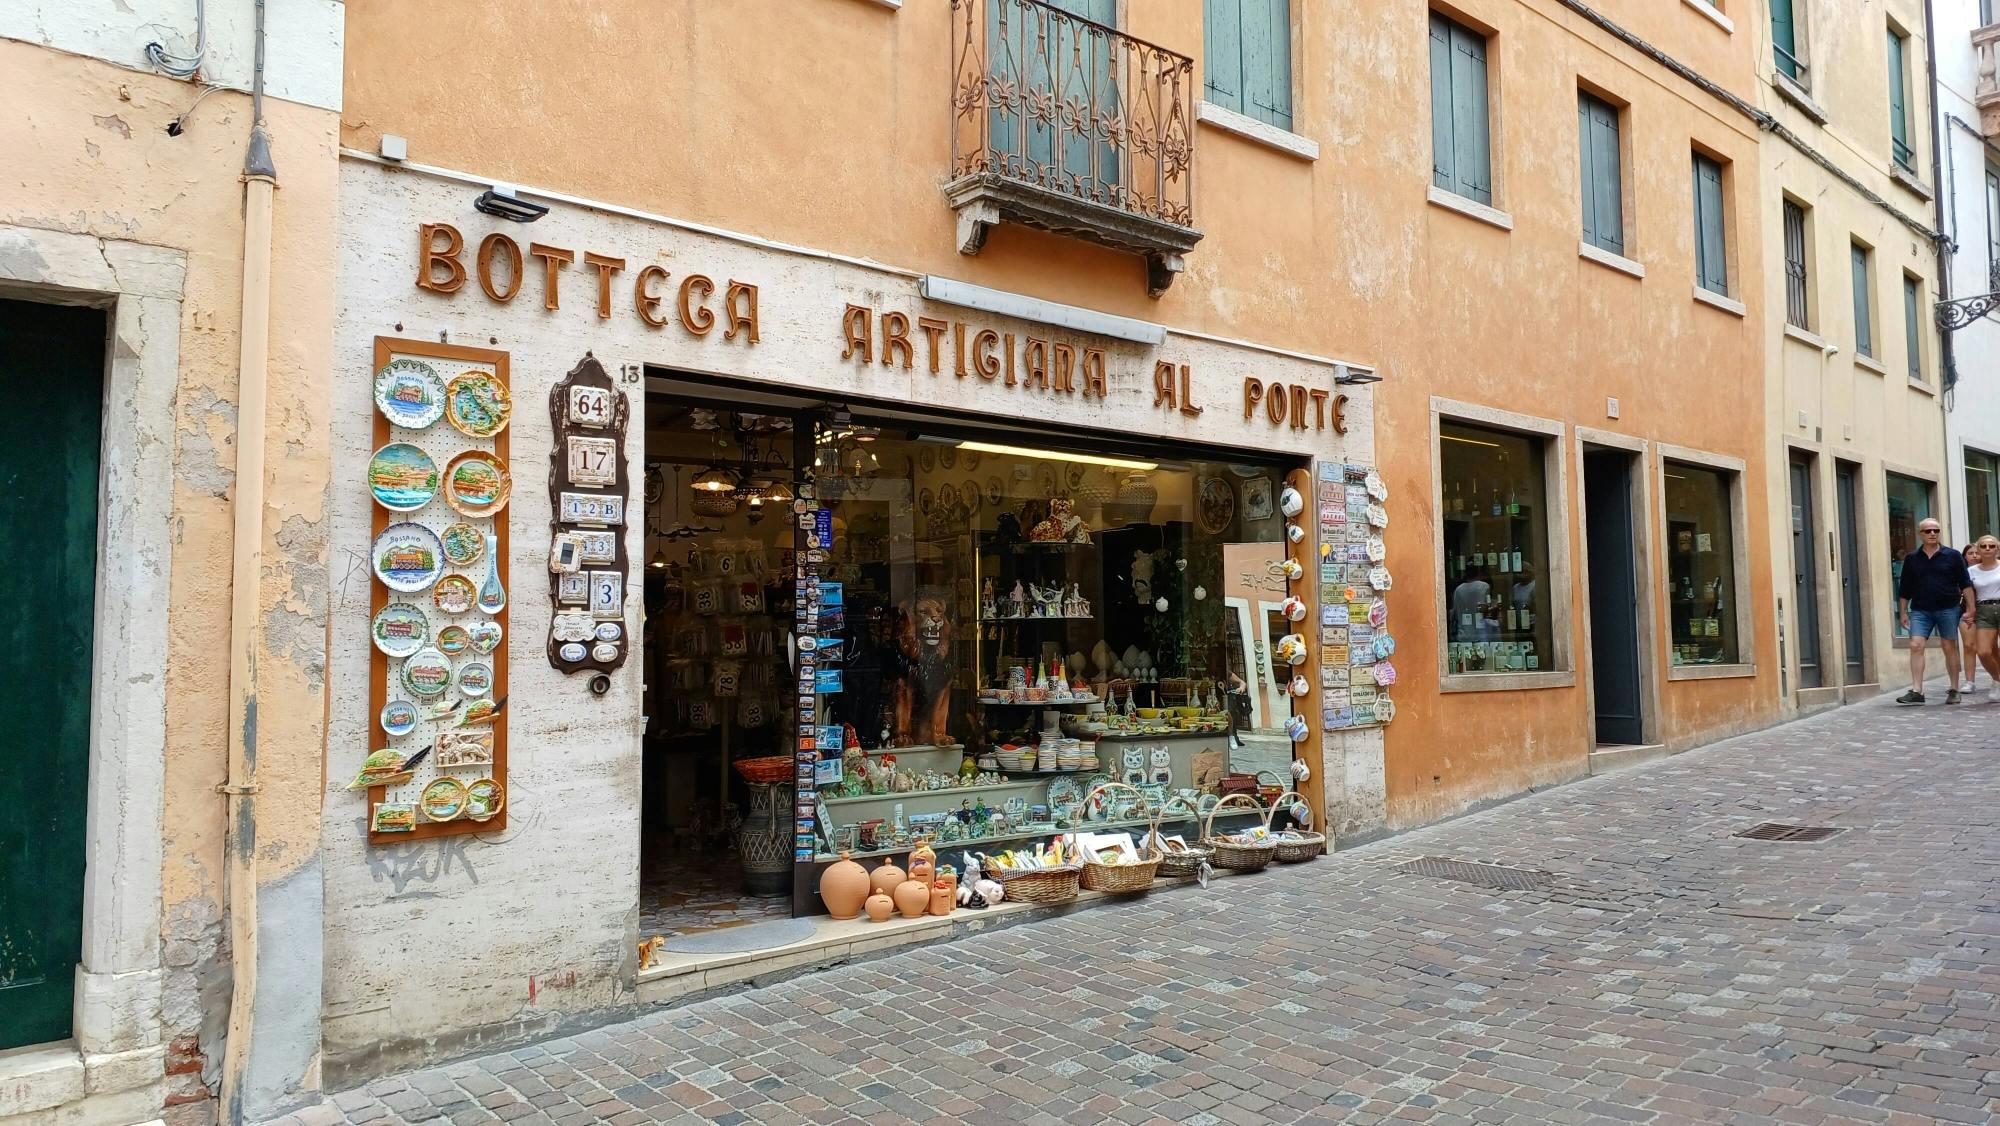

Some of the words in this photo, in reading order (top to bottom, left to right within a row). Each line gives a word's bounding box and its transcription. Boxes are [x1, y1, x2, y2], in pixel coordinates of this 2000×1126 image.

[415, 222, 760, 345] BOTTEGA
[841, 301, 1107, 397] ARTIGIANA
[1154, 359, 1204, 416] AL
[1244, 376, 1349, 434] PONTE
[620, 364, 640, 384] 13
[578, 394, 604, 417] 64
[581, 450, 607, 470] 17
[722, 558, 731, 571] 6
[571, 580, 577, 590] 1
[601, 584, 612, 604] 3
[698, 591, 712, 609] 38
[720, 676, 733, 692] 78
[748, 706, 761, 724] 88
